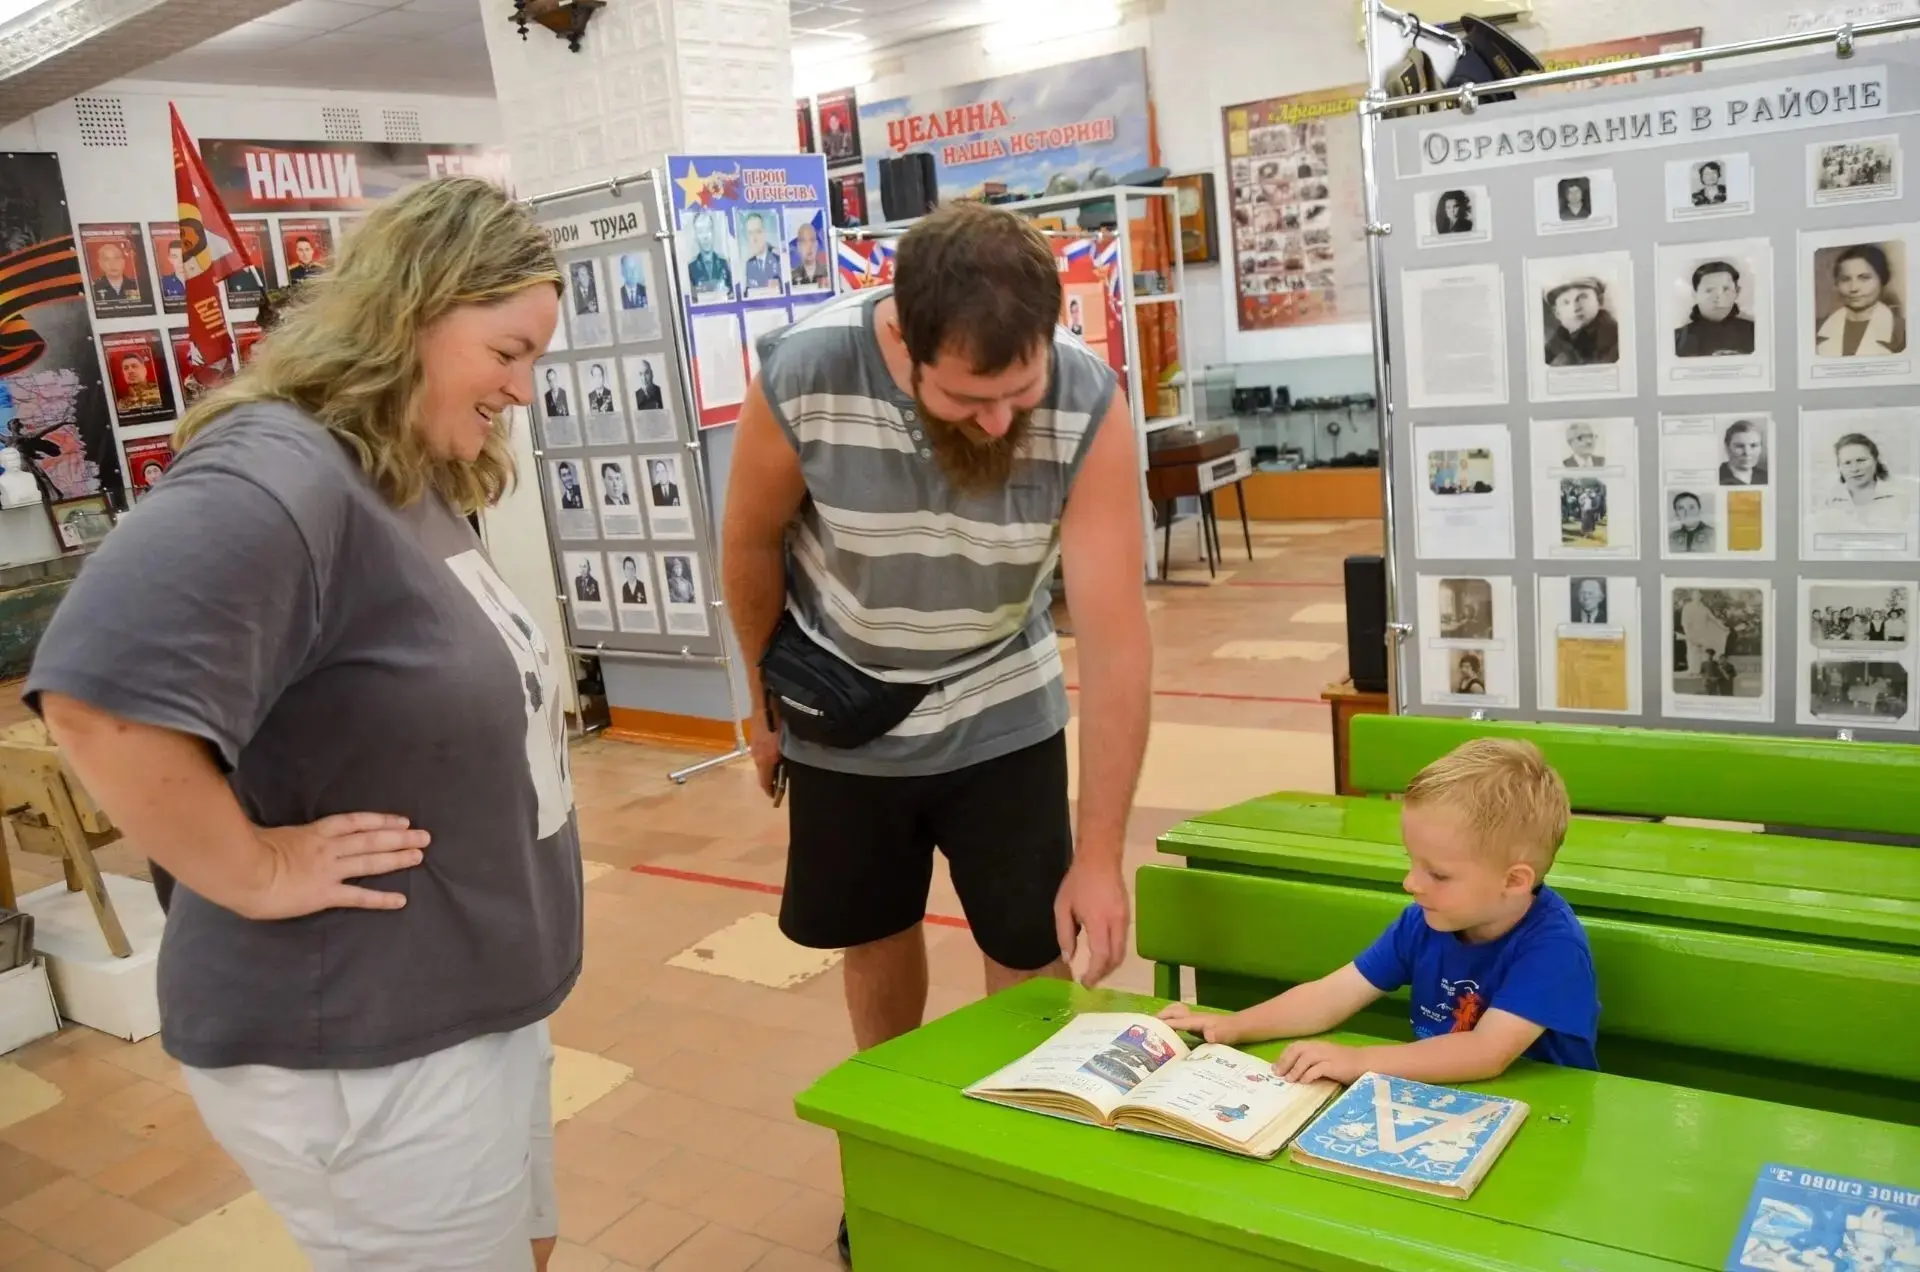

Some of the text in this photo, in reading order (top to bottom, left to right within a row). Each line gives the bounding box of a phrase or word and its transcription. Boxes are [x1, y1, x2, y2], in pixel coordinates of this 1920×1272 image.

[1691, 106, 1712, 131] В
[1727, 81, 1881, 126] РАЙОНЕ
[943, 117, 1116, 166] НАША ИСТОРИЯ!
[245, 152, 363, 200] НАШИ
[742, 168, 786, 186] ГЕРОИ
[744, 185, 817, 202] ОТЕЧЕСТВА
[545, 212, 638, 248] ерои труда
[1314, 1134, 1456, 1175] БУКАРЬ
[1800, 1173, 1862, 1195] СЛОВО
